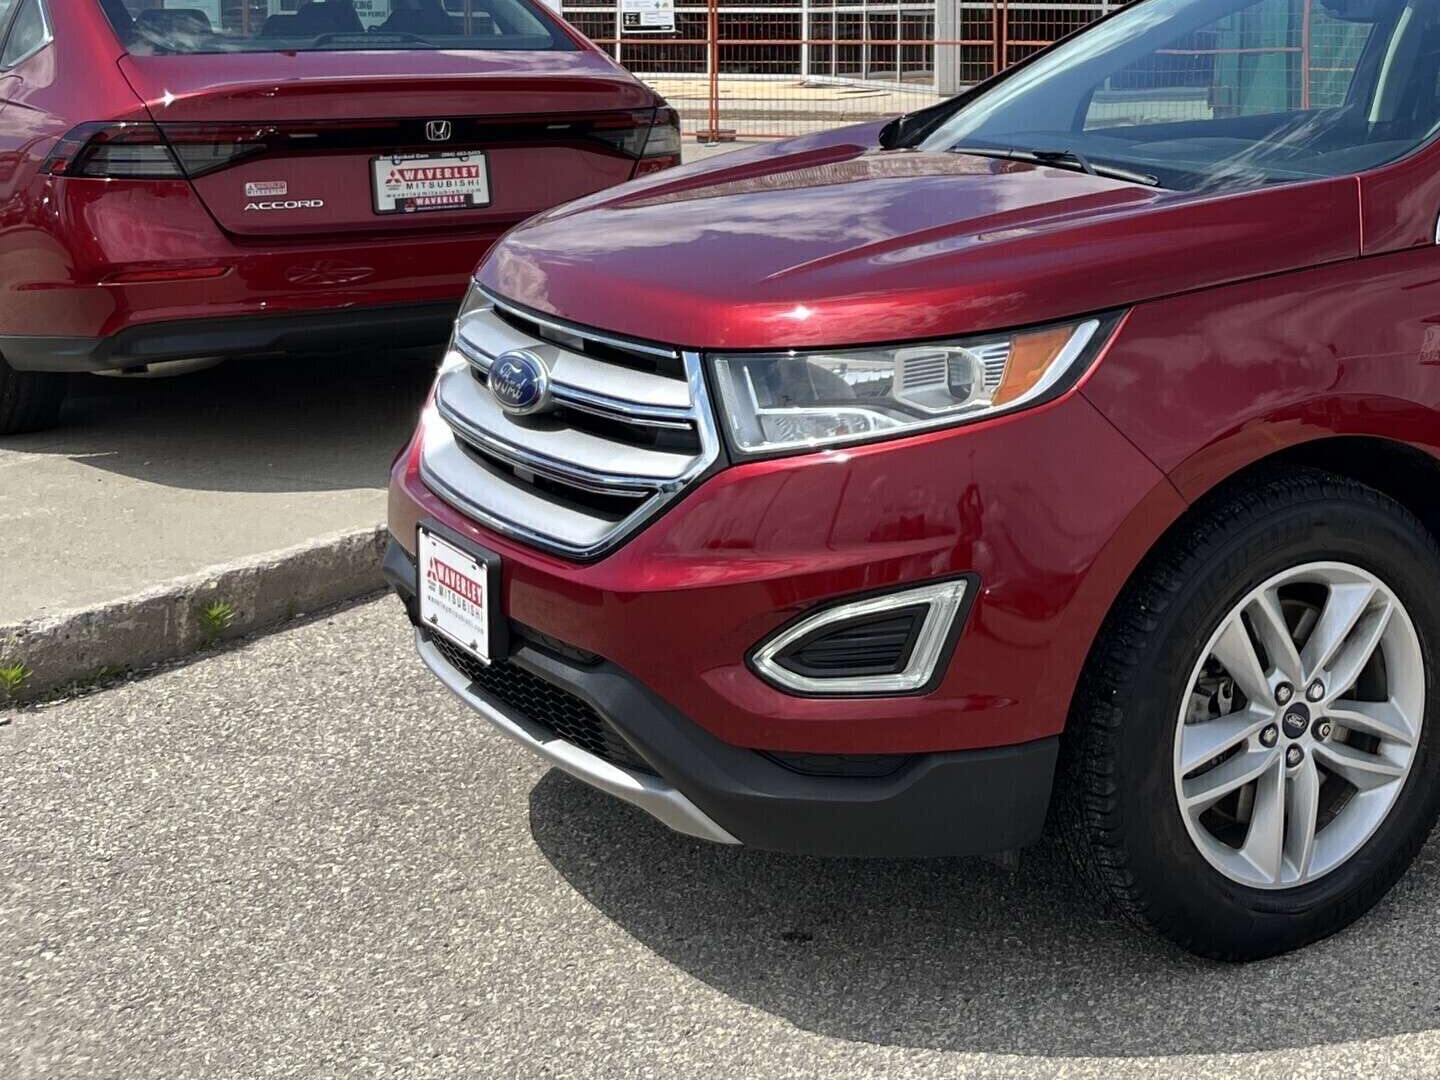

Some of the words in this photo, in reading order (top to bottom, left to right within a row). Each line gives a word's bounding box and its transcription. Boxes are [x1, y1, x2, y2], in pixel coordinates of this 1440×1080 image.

[403, 167, 479, 181] WAVERLEY
[406, 179, 480, 190] MITSUBISHI
[244, 200, 324, 211] ACCORD
[438, 562, 483, 607] WAVERLEY
